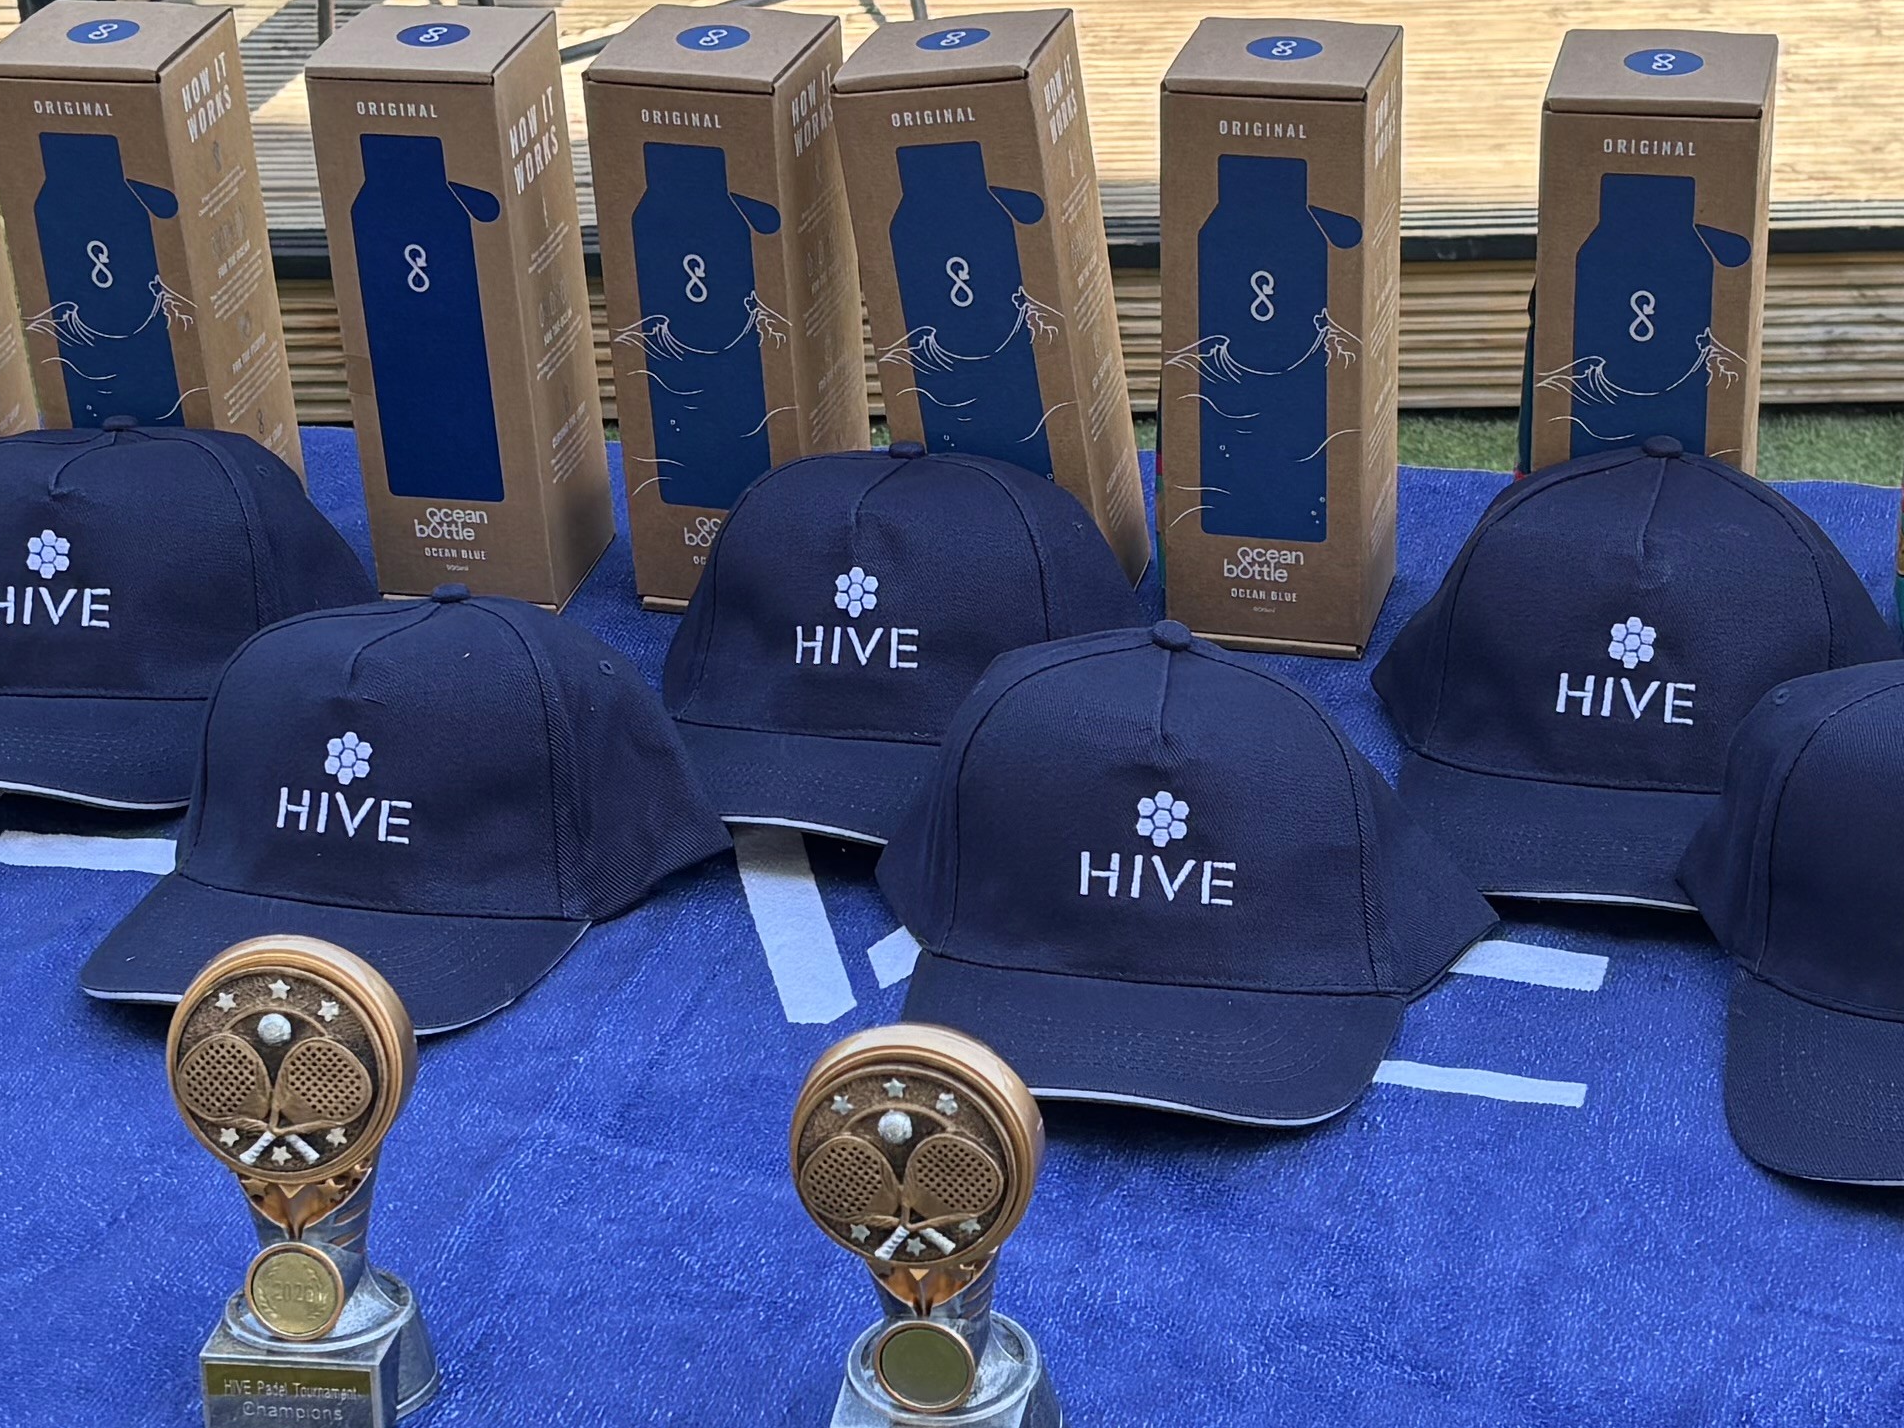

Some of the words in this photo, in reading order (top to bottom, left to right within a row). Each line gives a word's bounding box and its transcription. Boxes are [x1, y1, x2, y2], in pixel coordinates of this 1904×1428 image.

[181, 67, 211, 113] HOW
[214, 52, 227, 83] IT
[33, 100, 113, 116] ORIGINAL
[187, 84, 232, 143] WORKS
[357, 101, 438, 118] ORIGINAL
[791, 79, 817, 127] HOW
[509, 104, 538, 159] HOW
[542, 86, 554, 123] IT
[641, 109, 722, 129] ORIGINAL
[794, 99, 834, 157] WORKS
[891, 107, 976, 127] ORIGINAL
[1219, 120, 1307, 139] ORIGINAL
[1603, 138, 1696, 156] ORIGINAL
[513, 125, 559, 196] WORKS
[426, 507, 488, 524] ocean
[414, 519, 475, 541] bottle
[1237, 546, 1304, 565] ocean
[1223, 558, 1288, 582] bottle
[795, 625, 919, 669] HIVE
[1555, 673, 1696, 725] HIVE
[276, 785, 413, 845] HIVE
[1079, 851, 1237, 906] HIVE
[223, 1378, 251, 1397] HIVE
[257, 1380, 288, 1398] Padel
[292, 1382, 359, 1403] Tournament
[242, 1401, 343, 1422] Champions
